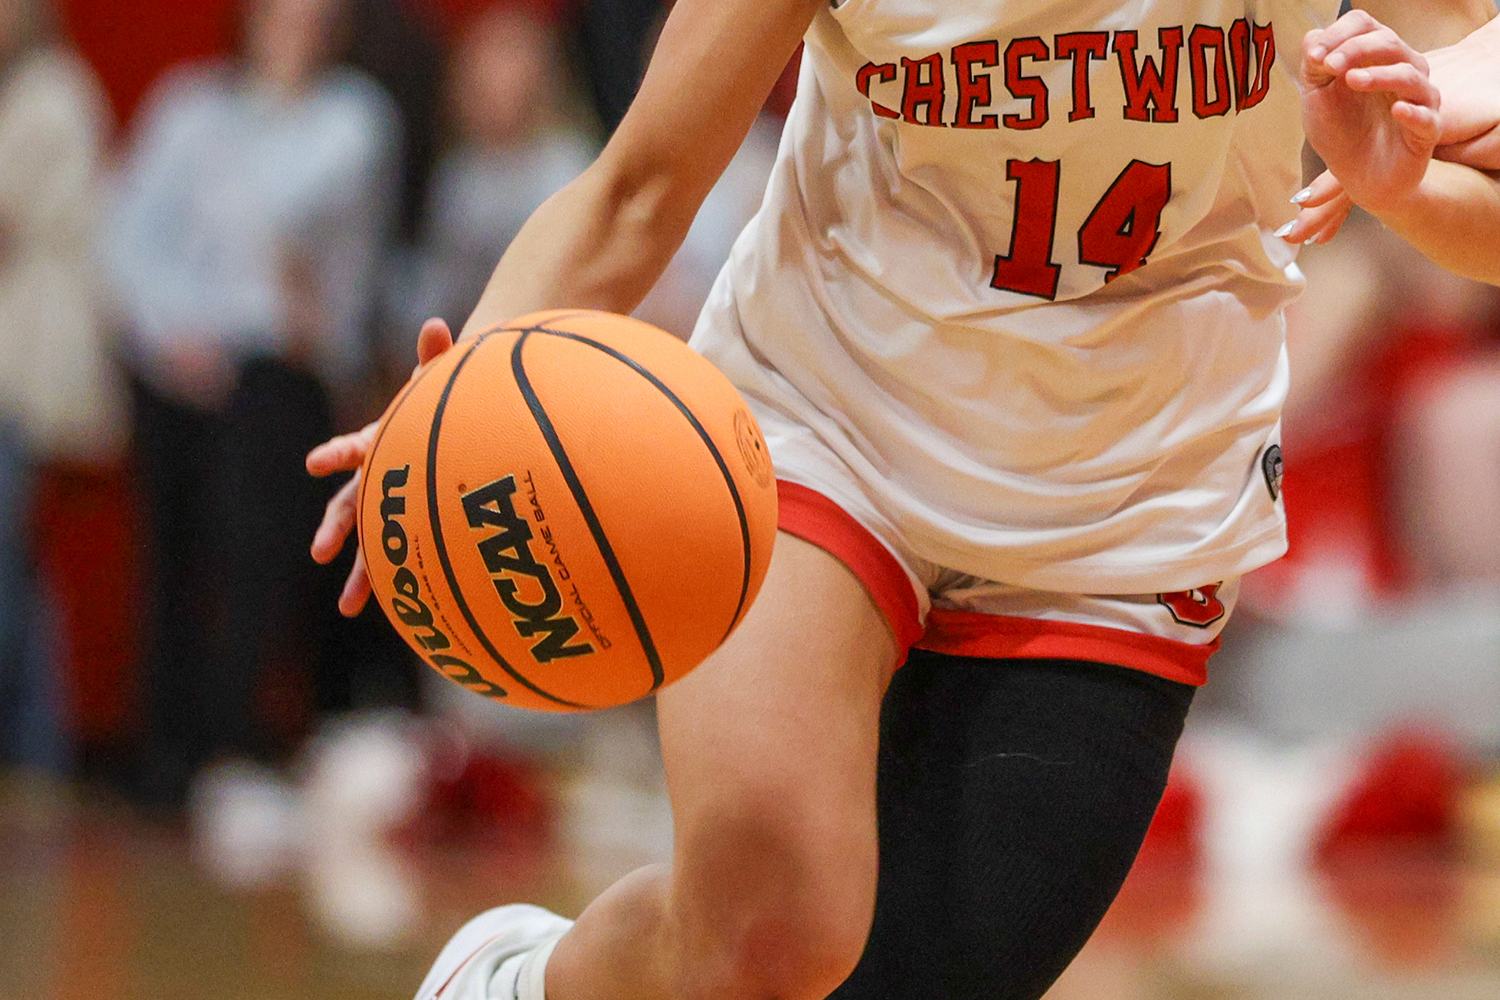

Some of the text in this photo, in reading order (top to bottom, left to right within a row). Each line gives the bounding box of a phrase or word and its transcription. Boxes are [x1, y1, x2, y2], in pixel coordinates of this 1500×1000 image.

[989, 156, 1172, 301] 14
[461, 473, 598, 664] NCAA
[524, 470, 545, 522] BALL
[380, 464, 508, 698] Wilson
